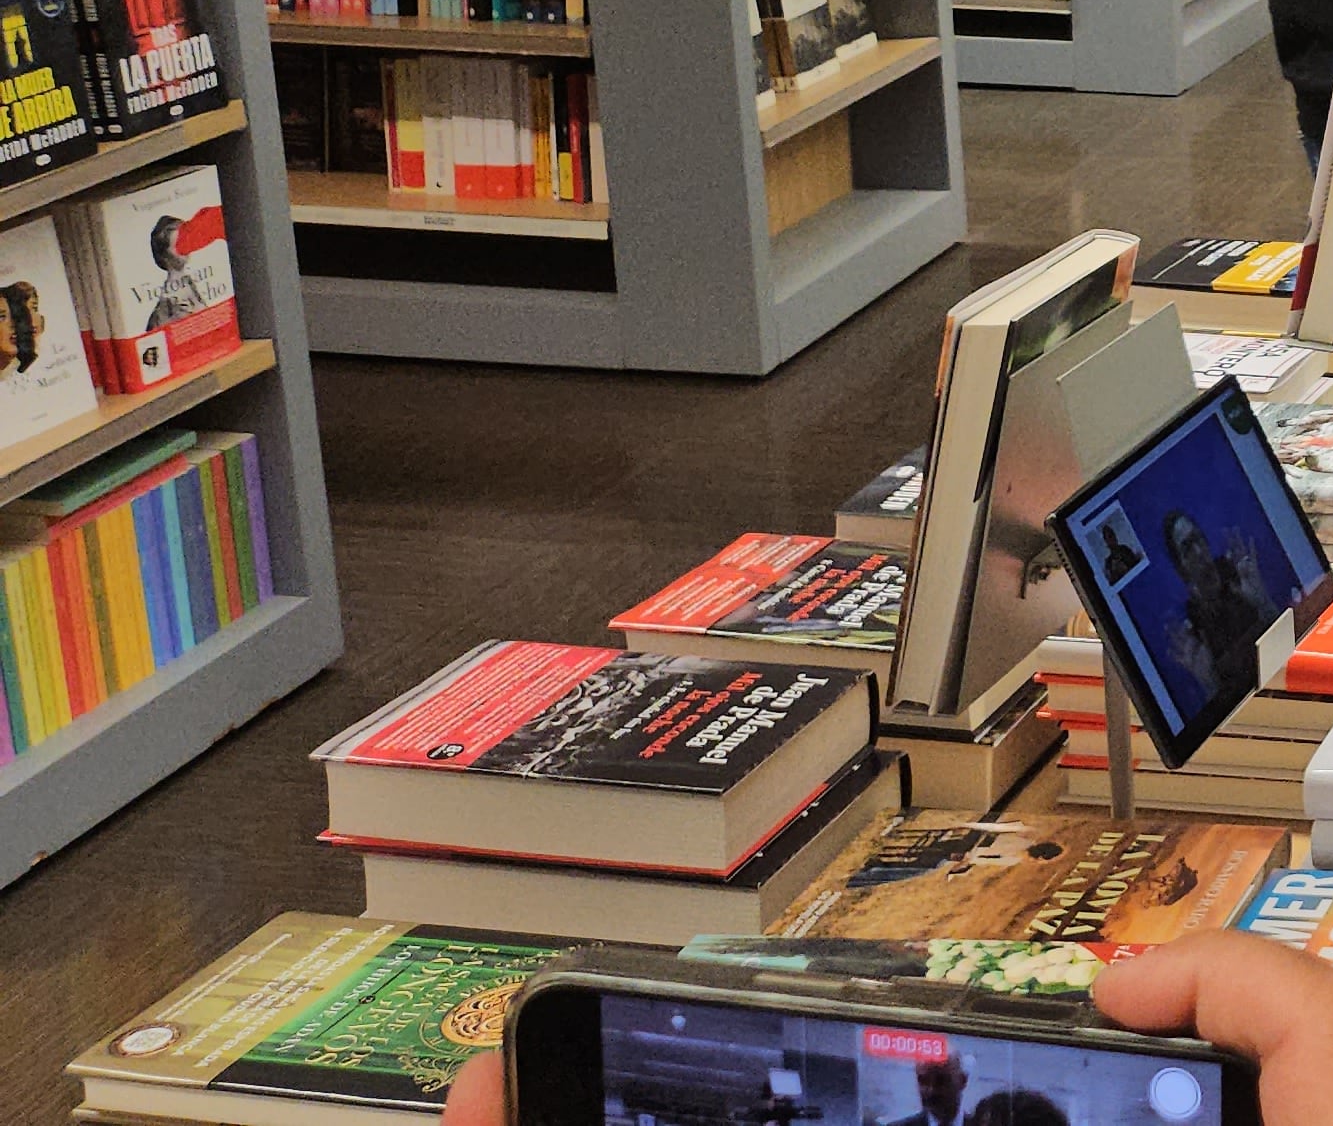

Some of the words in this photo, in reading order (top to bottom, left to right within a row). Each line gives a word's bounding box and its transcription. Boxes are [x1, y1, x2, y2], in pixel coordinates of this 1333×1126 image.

[119, 54, 149, 94] LA
[145, 33, 216, 84] PUERTA
[12, 85, 78, 135] ARRIBA
[130, 264, 215, 305] Victorian
[872, 565, 904, 582] de
[826, 581, 888, 615] Prada
[839, 583, 906, 628] Manuel
[685, 689, 713, 701] la
[728, 671, 763, 691] Mil
[743, 685, 778, 705] de
[770, 673, 829, 709] Juan
[642, 700, 692, 734] noche
[697, 690, 731, 714] ojos
[639, 714, 701, 760] esconde
[685, 706, 759, 748] Prada
[699, 709, 788, 765] Manuel
[1083, 830, 1126, 857] DE
[1118, 832, 1169, 860] LA
[1059, 860, 1103, 886] LA
[1020, 890, 1087, 935] PAZ
[1058, 866, 1144, 936] NOVIA
[382, 944, 422, 966] LOS
[459, 946, 501, 966] LA
[341, 967, 393, 999] HIJOS
[410, 969, 472, 1007] SAGA
[298, 943, 476, 1066] LONGEVOS
[315, 1001, 350, 1017] DE
[381, 1011, 422, 1031] DE
[334, 1036, 392, 1068] LOS
[870, 1032, 943, 1057] 00:00:53
